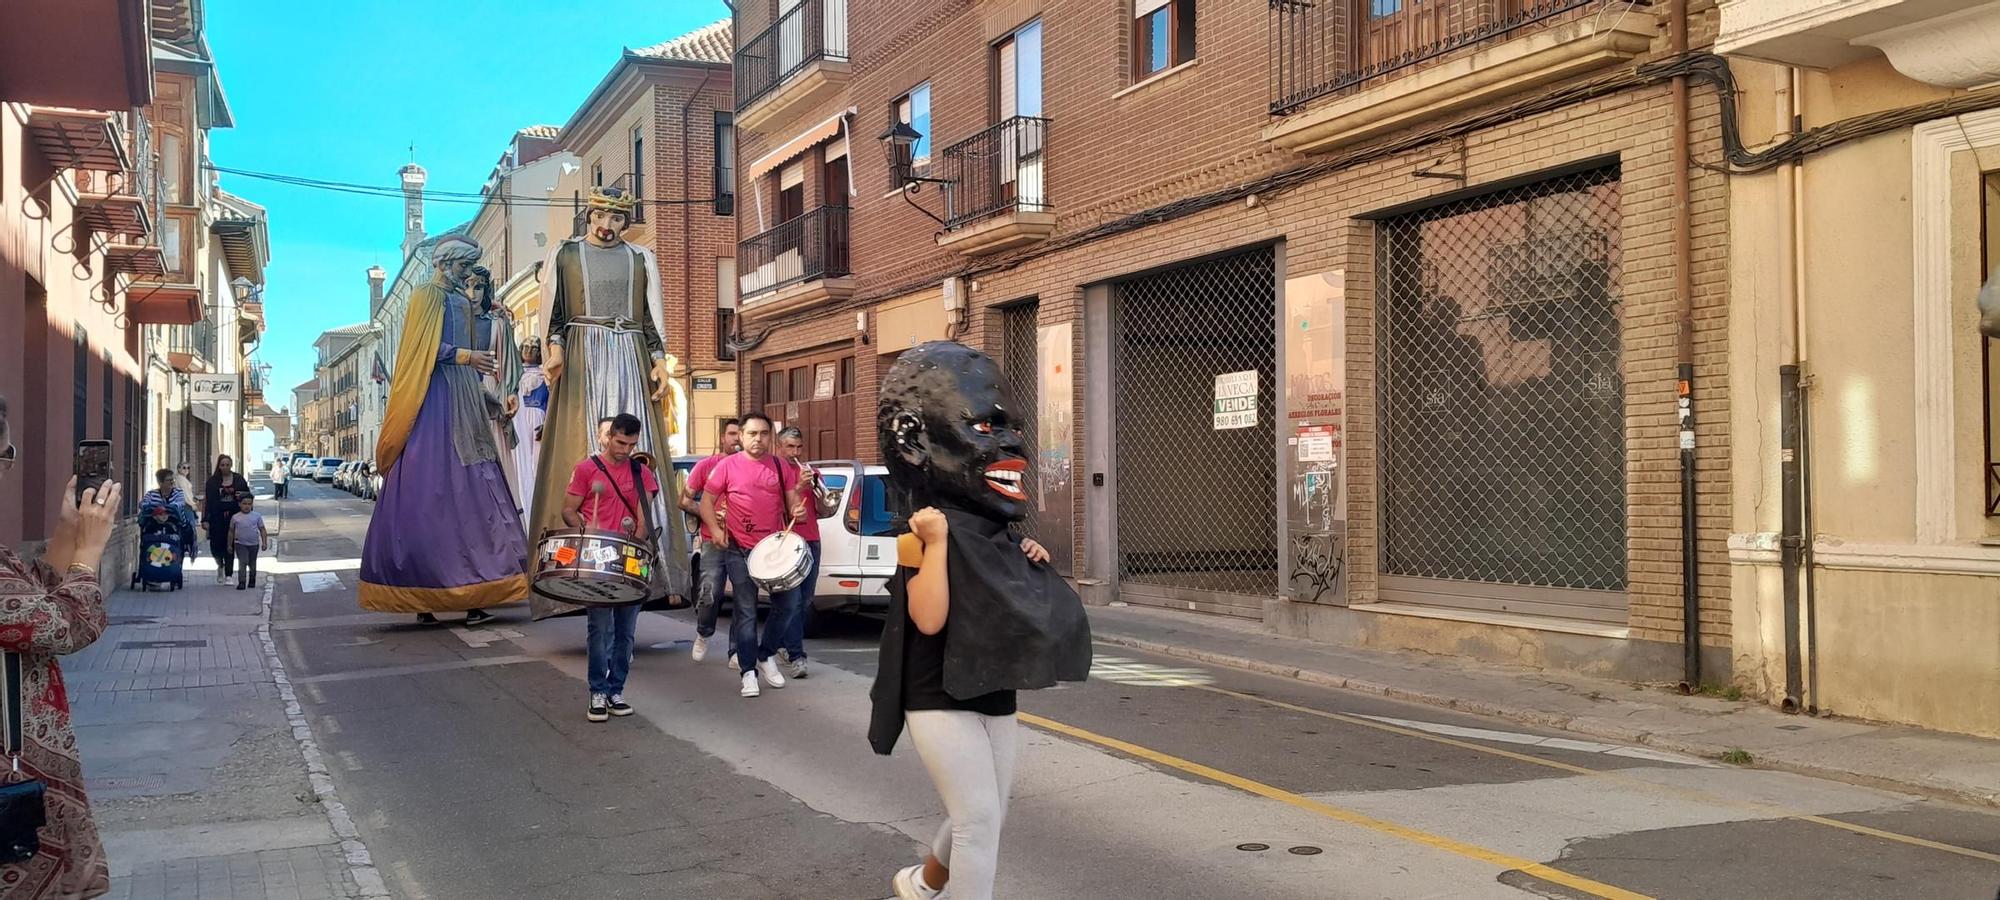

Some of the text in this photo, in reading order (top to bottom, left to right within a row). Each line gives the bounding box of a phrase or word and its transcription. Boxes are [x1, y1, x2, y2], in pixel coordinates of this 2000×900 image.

[1218, 396, 1256, 412] VENDE
[1315, 408, 1342, 417] FLORALES
[1215, 415, 1229, 427] 980
